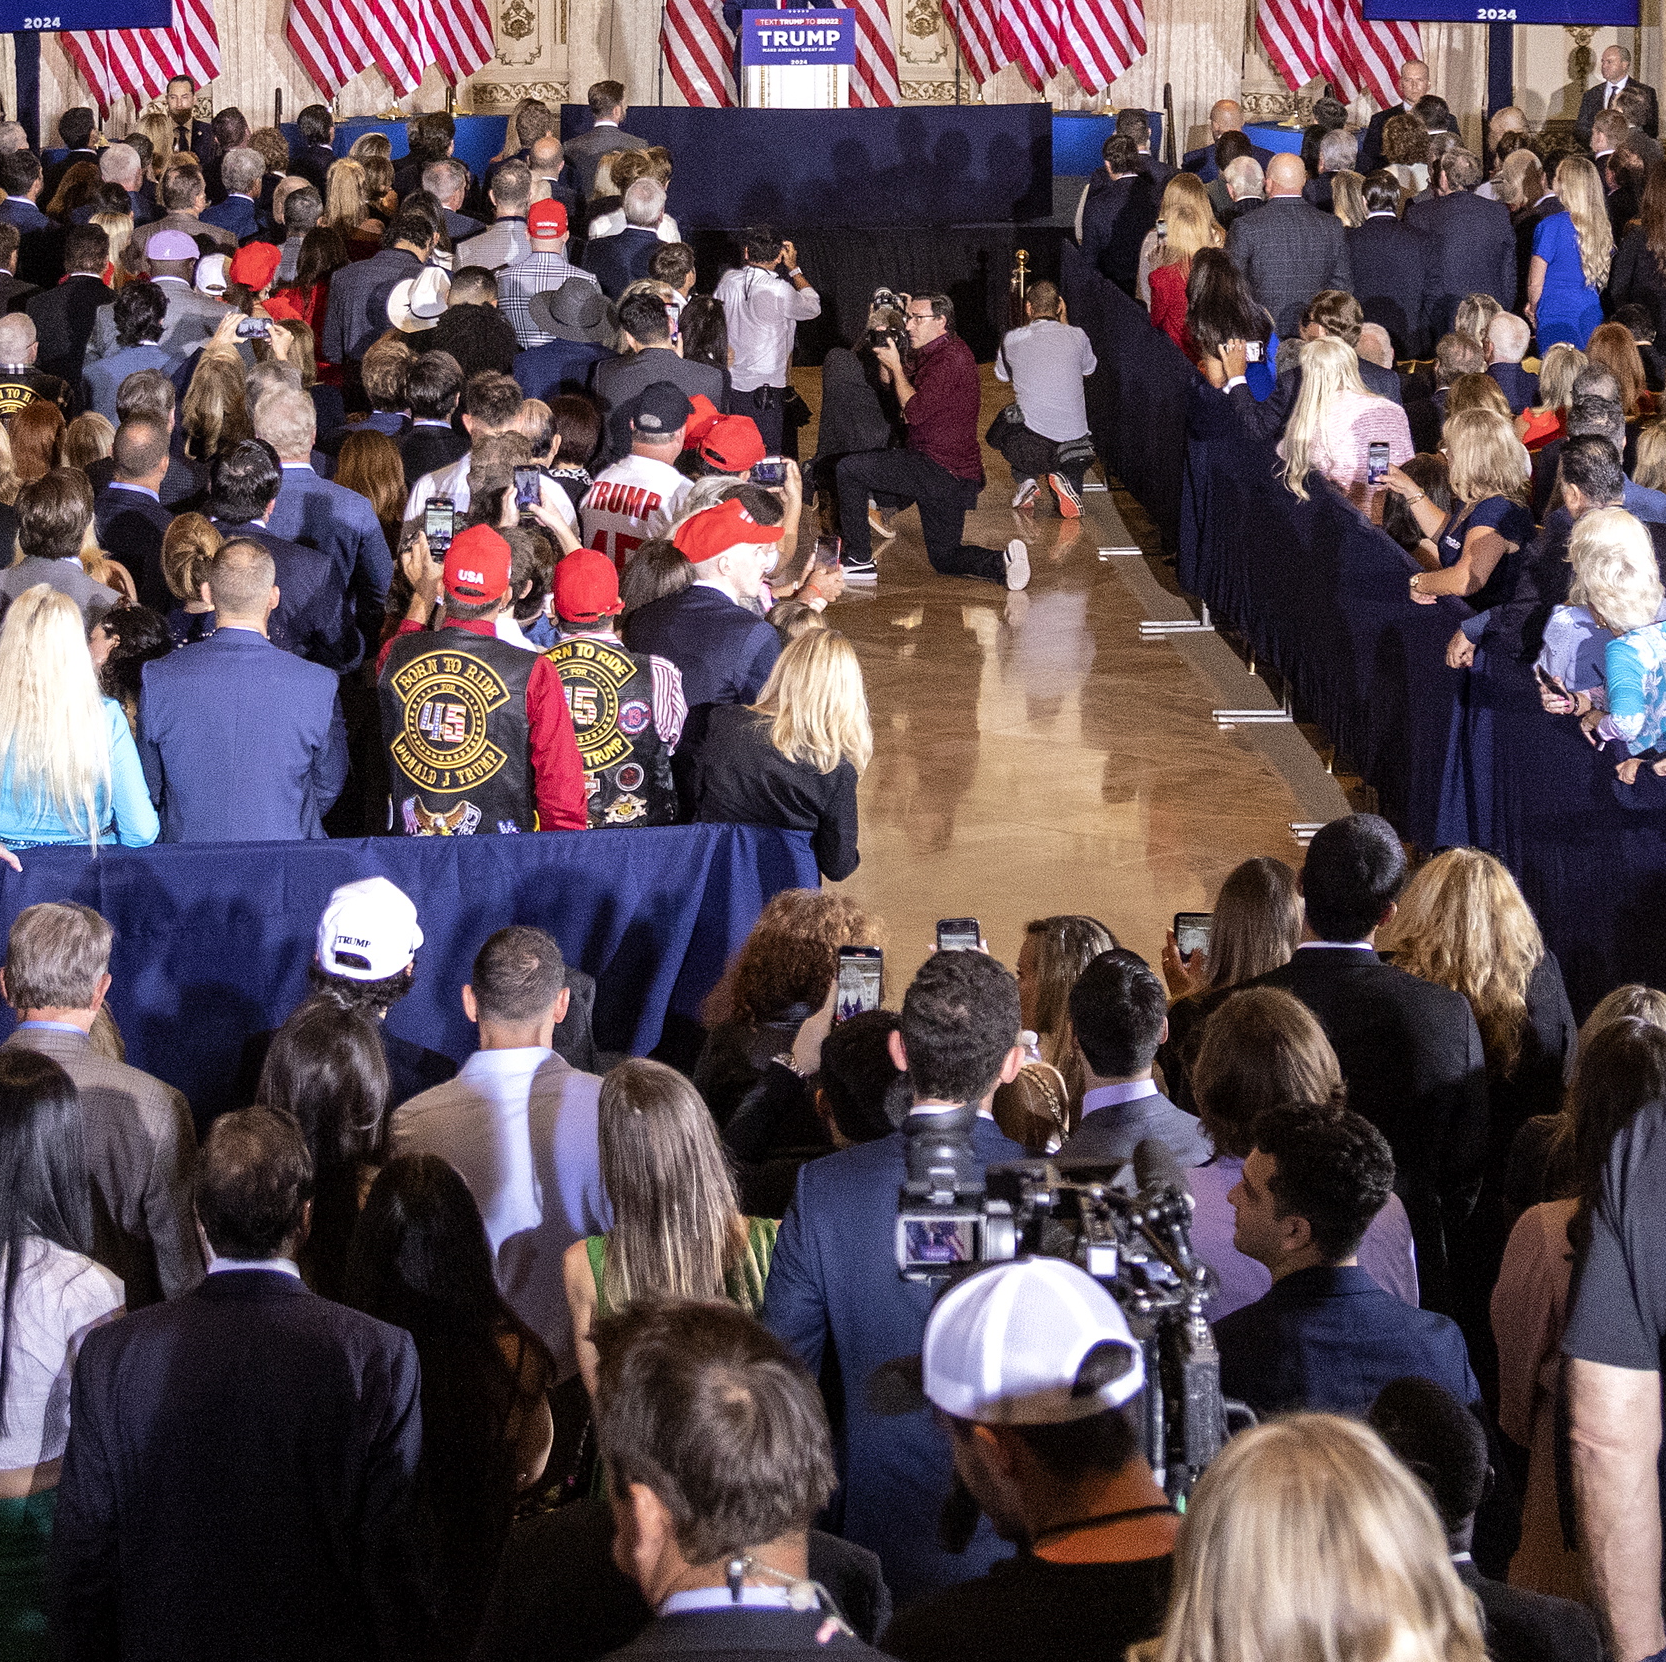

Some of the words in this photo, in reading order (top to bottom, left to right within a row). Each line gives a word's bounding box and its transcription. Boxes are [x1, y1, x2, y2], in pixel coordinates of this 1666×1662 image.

[1477, 8, 1517, 20] 2024
[23, 17, 61, 29] 2024
[758, 30, 840, 46] TRUMP
[6, 388, 20, 399] TO
[587, 481, 662, 521] TRUMP
[457, 569, 485, 585] USA
[547, 646, 573, 664] ORN
[575, 642, 595, 659] TO
[595, 650, 629, 678] RIDE
[398, 657, 438, 691] BORN
[443, 656, 462, 675] TO
[463, 663, 501, 701] RIDE
[571, 668, 588, 677] FOR
[441, 683, 456, 692] FOR
[419, 701, 468, 743] 45
[583, 738, 624, 768] TRUMP
[395, 742, 438, 785] DONALD
[441, 769, 451, 788] J
[455, 751, 500, 783] TRUMP
[337, 935, 372, 949] TRUMP
